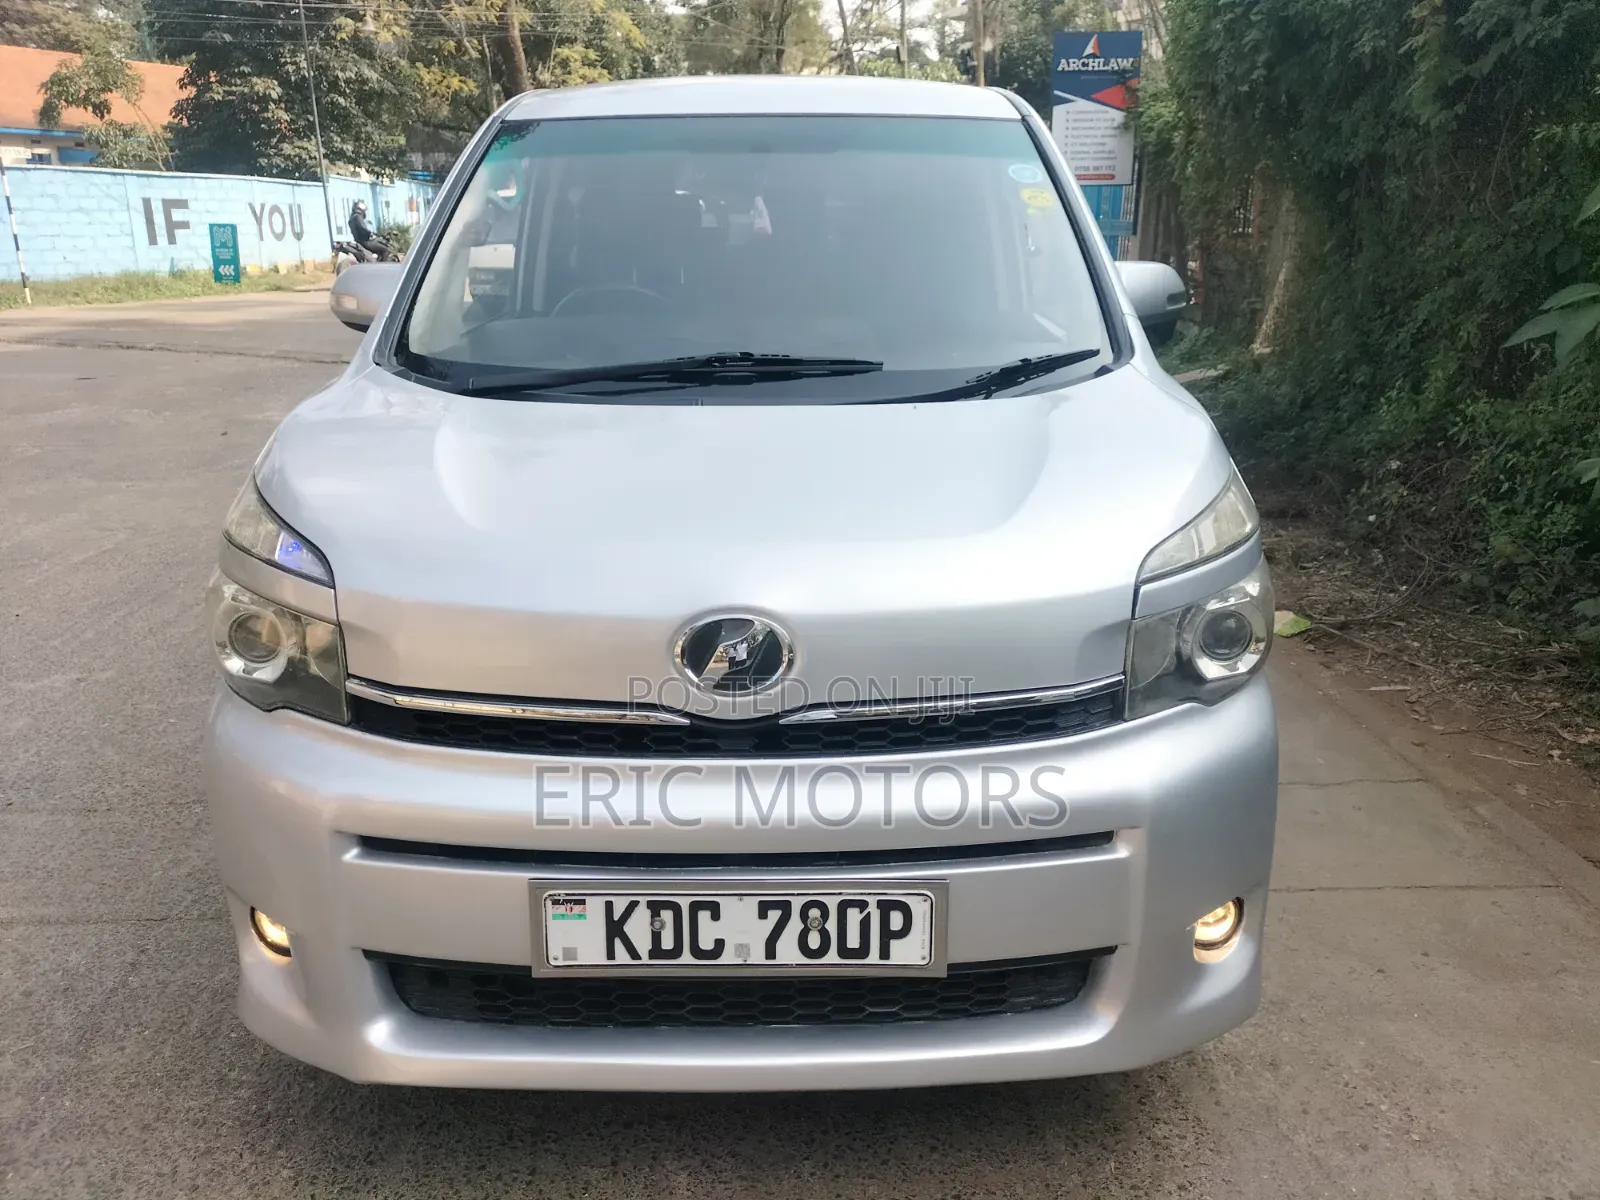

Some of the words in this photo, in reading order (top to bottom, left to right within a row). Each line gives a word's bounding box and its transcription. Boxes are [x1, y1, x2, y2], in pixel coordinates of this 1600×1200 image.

[1057, 57, 1134, 71] ARCHLAW
[142, 197, 191, 245] IF
[248, 203, 304, 242] YOU
[605, 900, 726, 960] KDC
[757, 900, 913, 961] 780P
